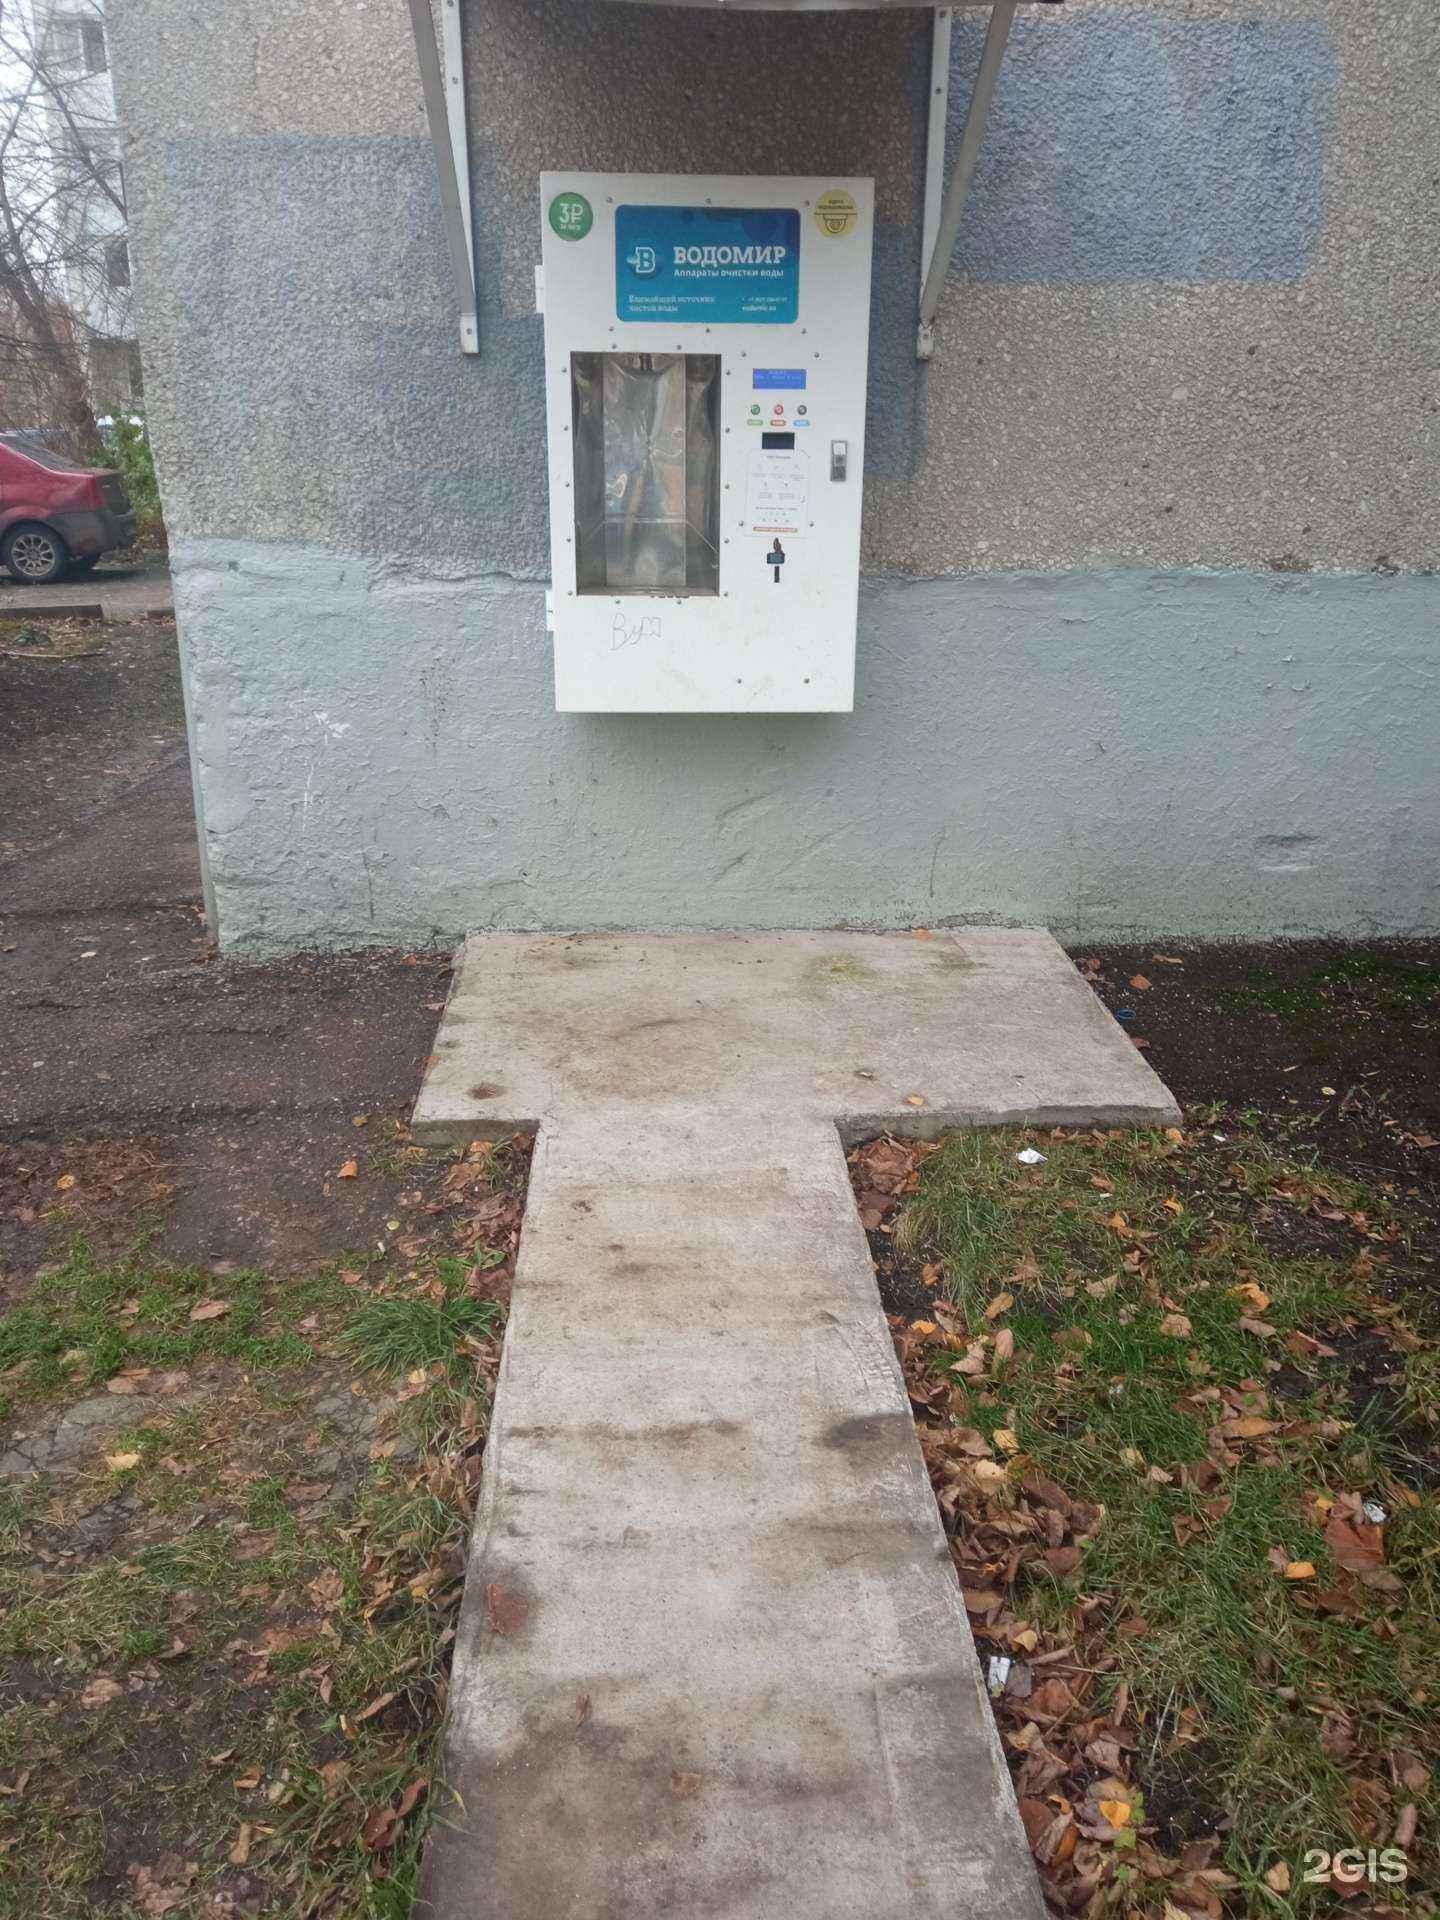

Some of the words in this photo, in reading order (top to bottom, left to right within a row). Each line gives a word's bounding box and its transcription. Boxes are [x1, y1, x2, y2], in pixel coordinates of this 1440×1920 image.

[673, 246, 786, 267] ВОДОМИР
[674, 269, 719, 278] Аппараты
[760, 270, 784, 278] воды
